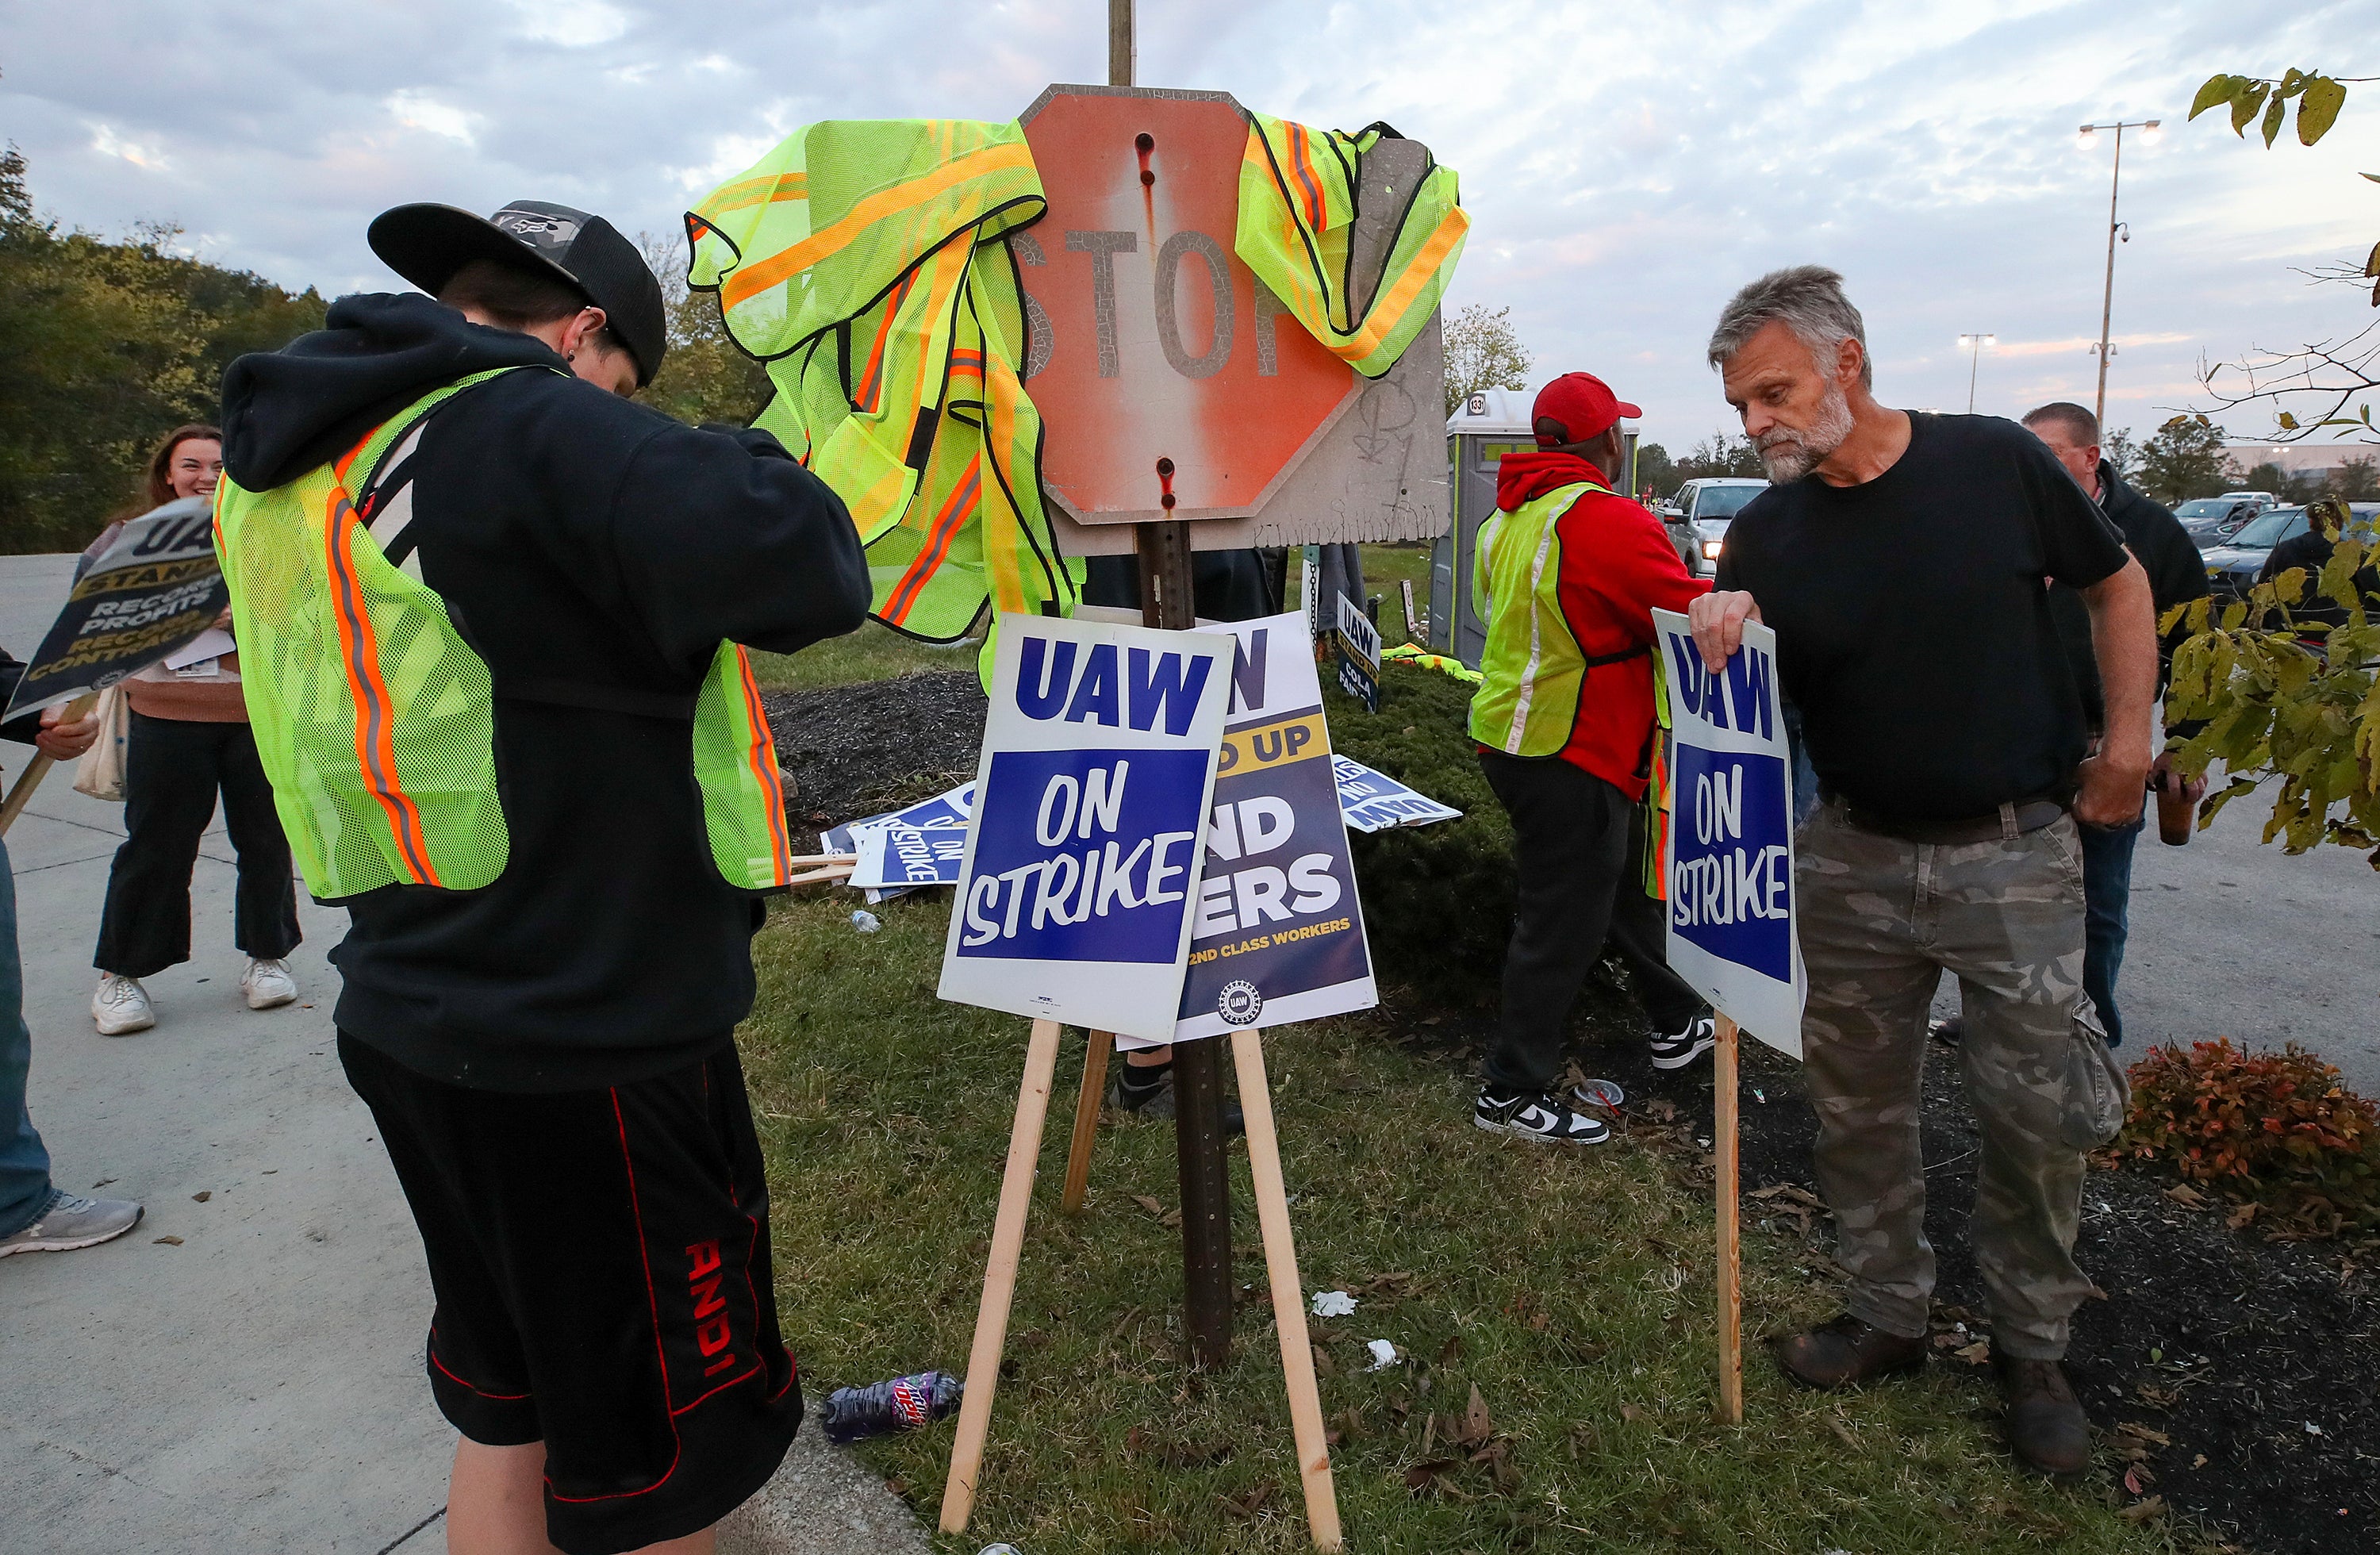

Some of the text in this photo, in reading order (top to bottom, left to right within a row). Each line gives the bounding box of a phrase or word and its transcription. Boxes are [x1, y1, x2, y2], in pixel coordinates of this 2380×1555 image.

[132, 516, 214, 556] UA
[79, 587, 213, 635] PROFITS
[1344, 603, 1374, 658] UAW
[1339, 636, 1377, 679] STAND UP
[1345, 662, 1371, 697] COLA
[1015, 636, 1214, 737] UAW
[1668, 632, 1773, 743] UAW
[1252, 724, 1311, 762] UP
[1035, 759, 1130, 847] ON
[1338, 781, 1379, 801] ON
[1347, 799, 1445, 827] UAW
[1695, 763, 1743, 845] ON
[931, 839, 964, 861] ON
[1203, 796, 1296, 866] ND
[891, 831, 939, 882] STRIKE
[962, 831, 1195, 946] STRIKE
[1193, 853, 1342, 940] ERS
[1674, 845, 1789, 927] STRIKE
[1188, 918, 1351, 966] 2ND CLASS WORKERS
[1230, 996, 1248, 1008] UAW
